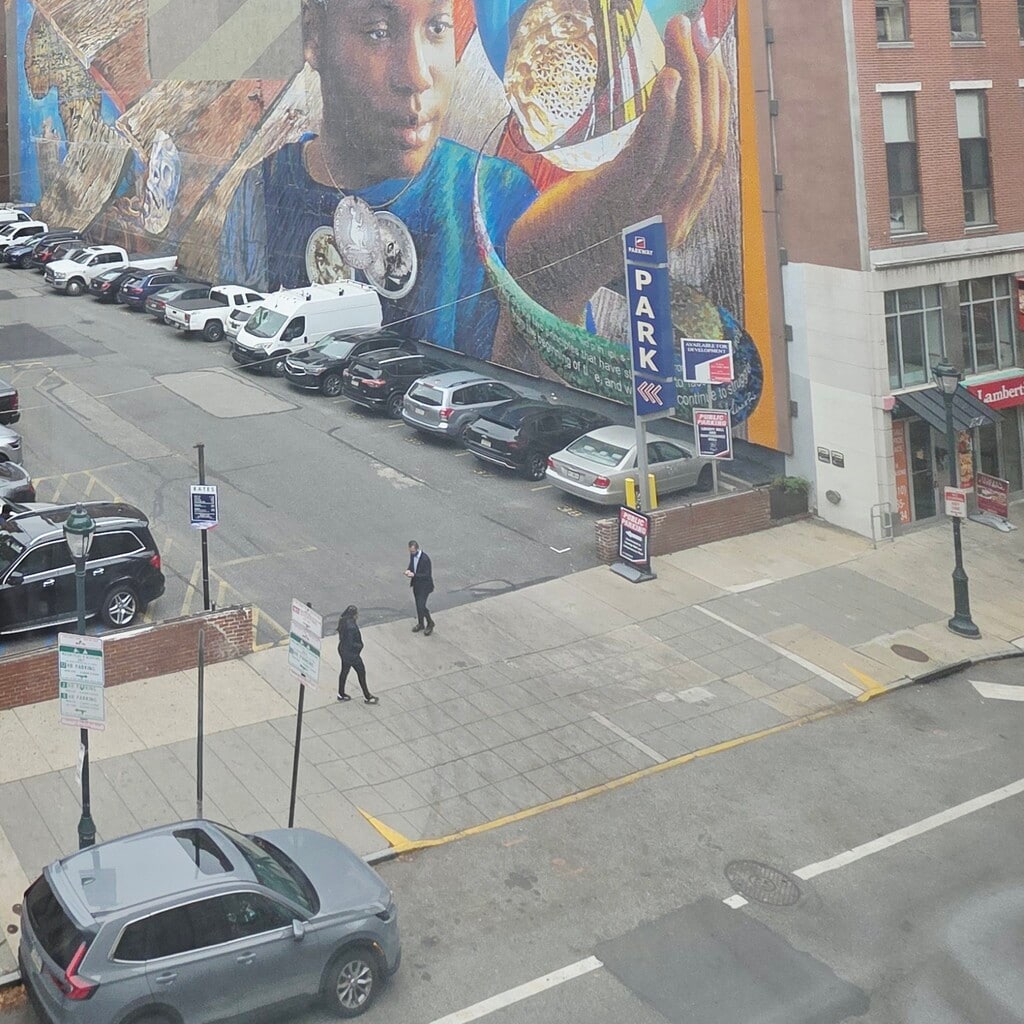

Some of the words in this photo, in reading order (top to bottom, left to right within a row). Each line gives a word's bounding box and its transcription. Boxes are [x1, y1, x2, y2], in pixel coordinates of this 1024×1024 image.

[634, 268, 659, 373] PARK
[598, 359, 622, 376] have
[605, 377, 623, 392] and
